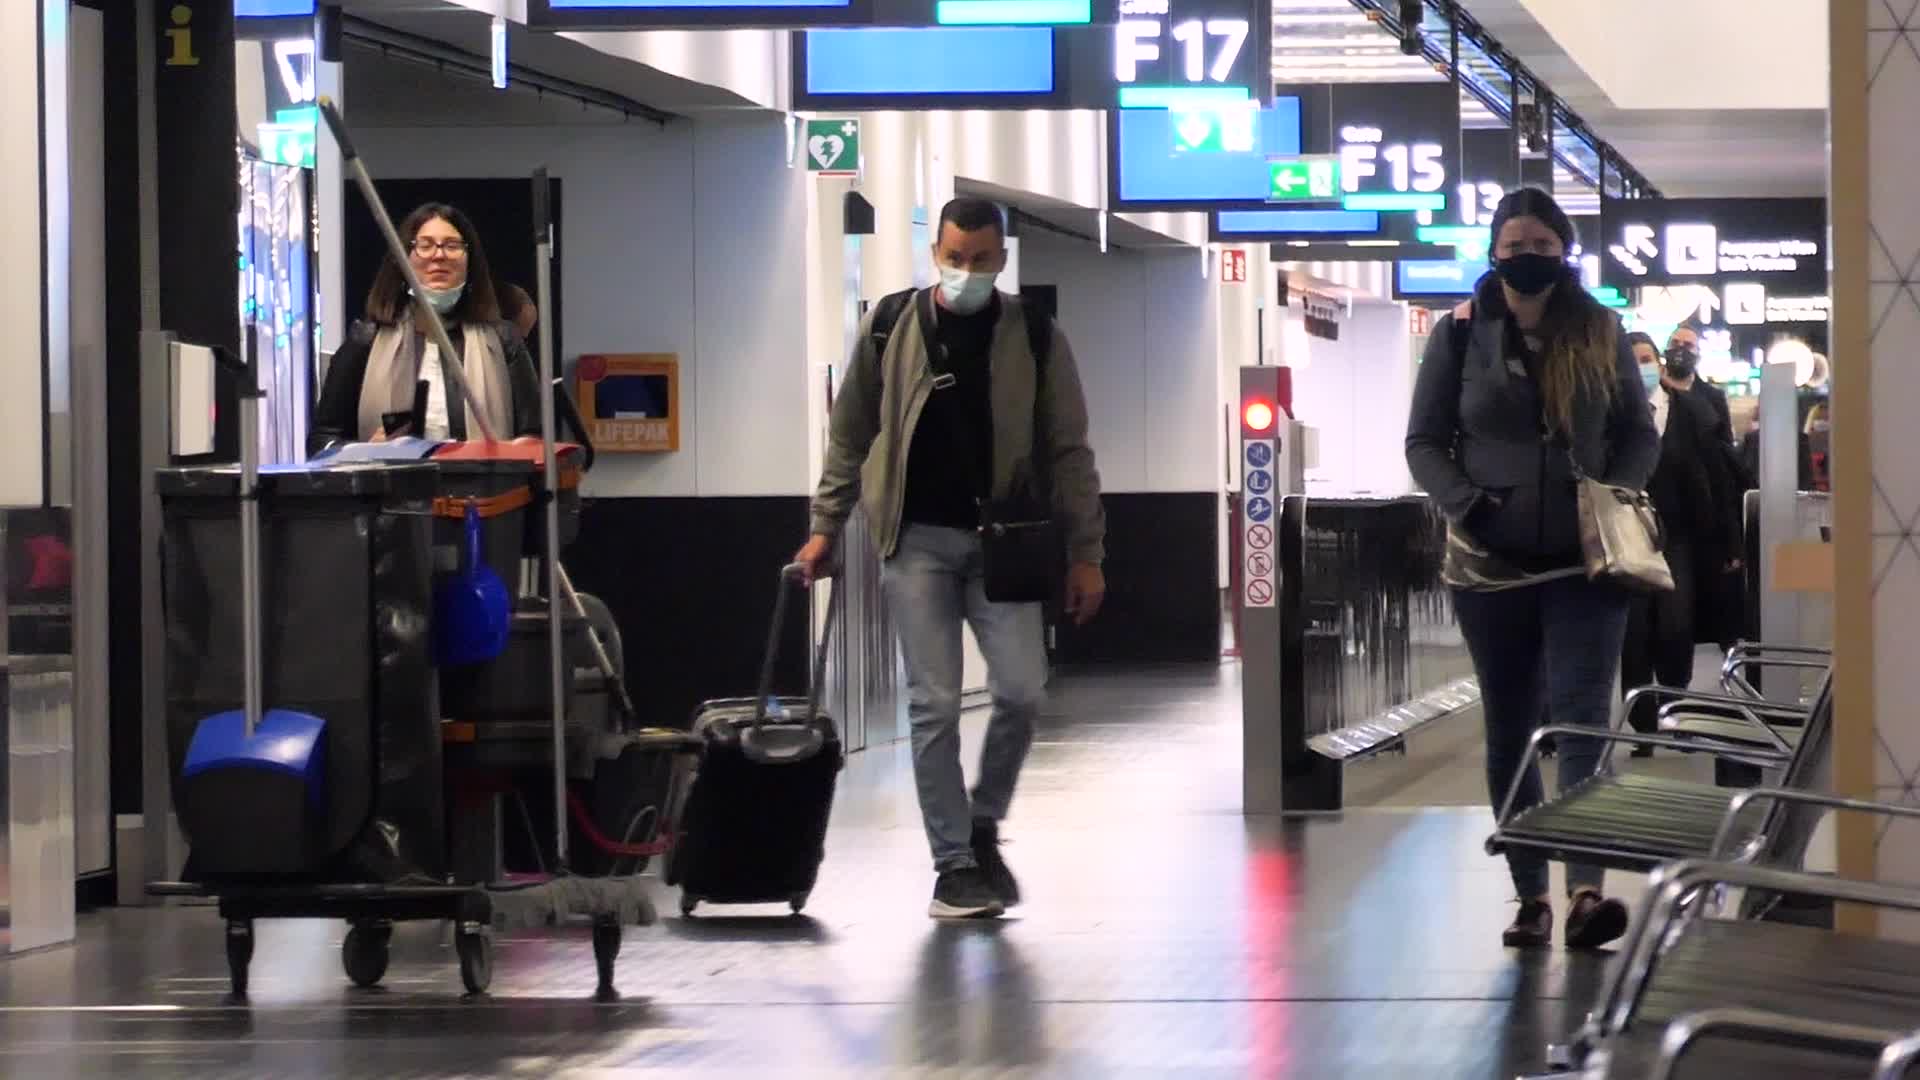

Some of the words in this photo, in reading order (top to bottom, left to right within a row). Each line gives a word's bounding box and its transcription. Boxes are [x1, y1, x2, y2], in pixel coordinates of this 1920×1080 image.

[1115, 20, 1161, 82] F
[1173, 20, 1249, 82] 17
[1341, 145, 1377, 192] F
[1384, 144, 1445, 192] 15
[593, 423, 670, 442] LIFEPAK
